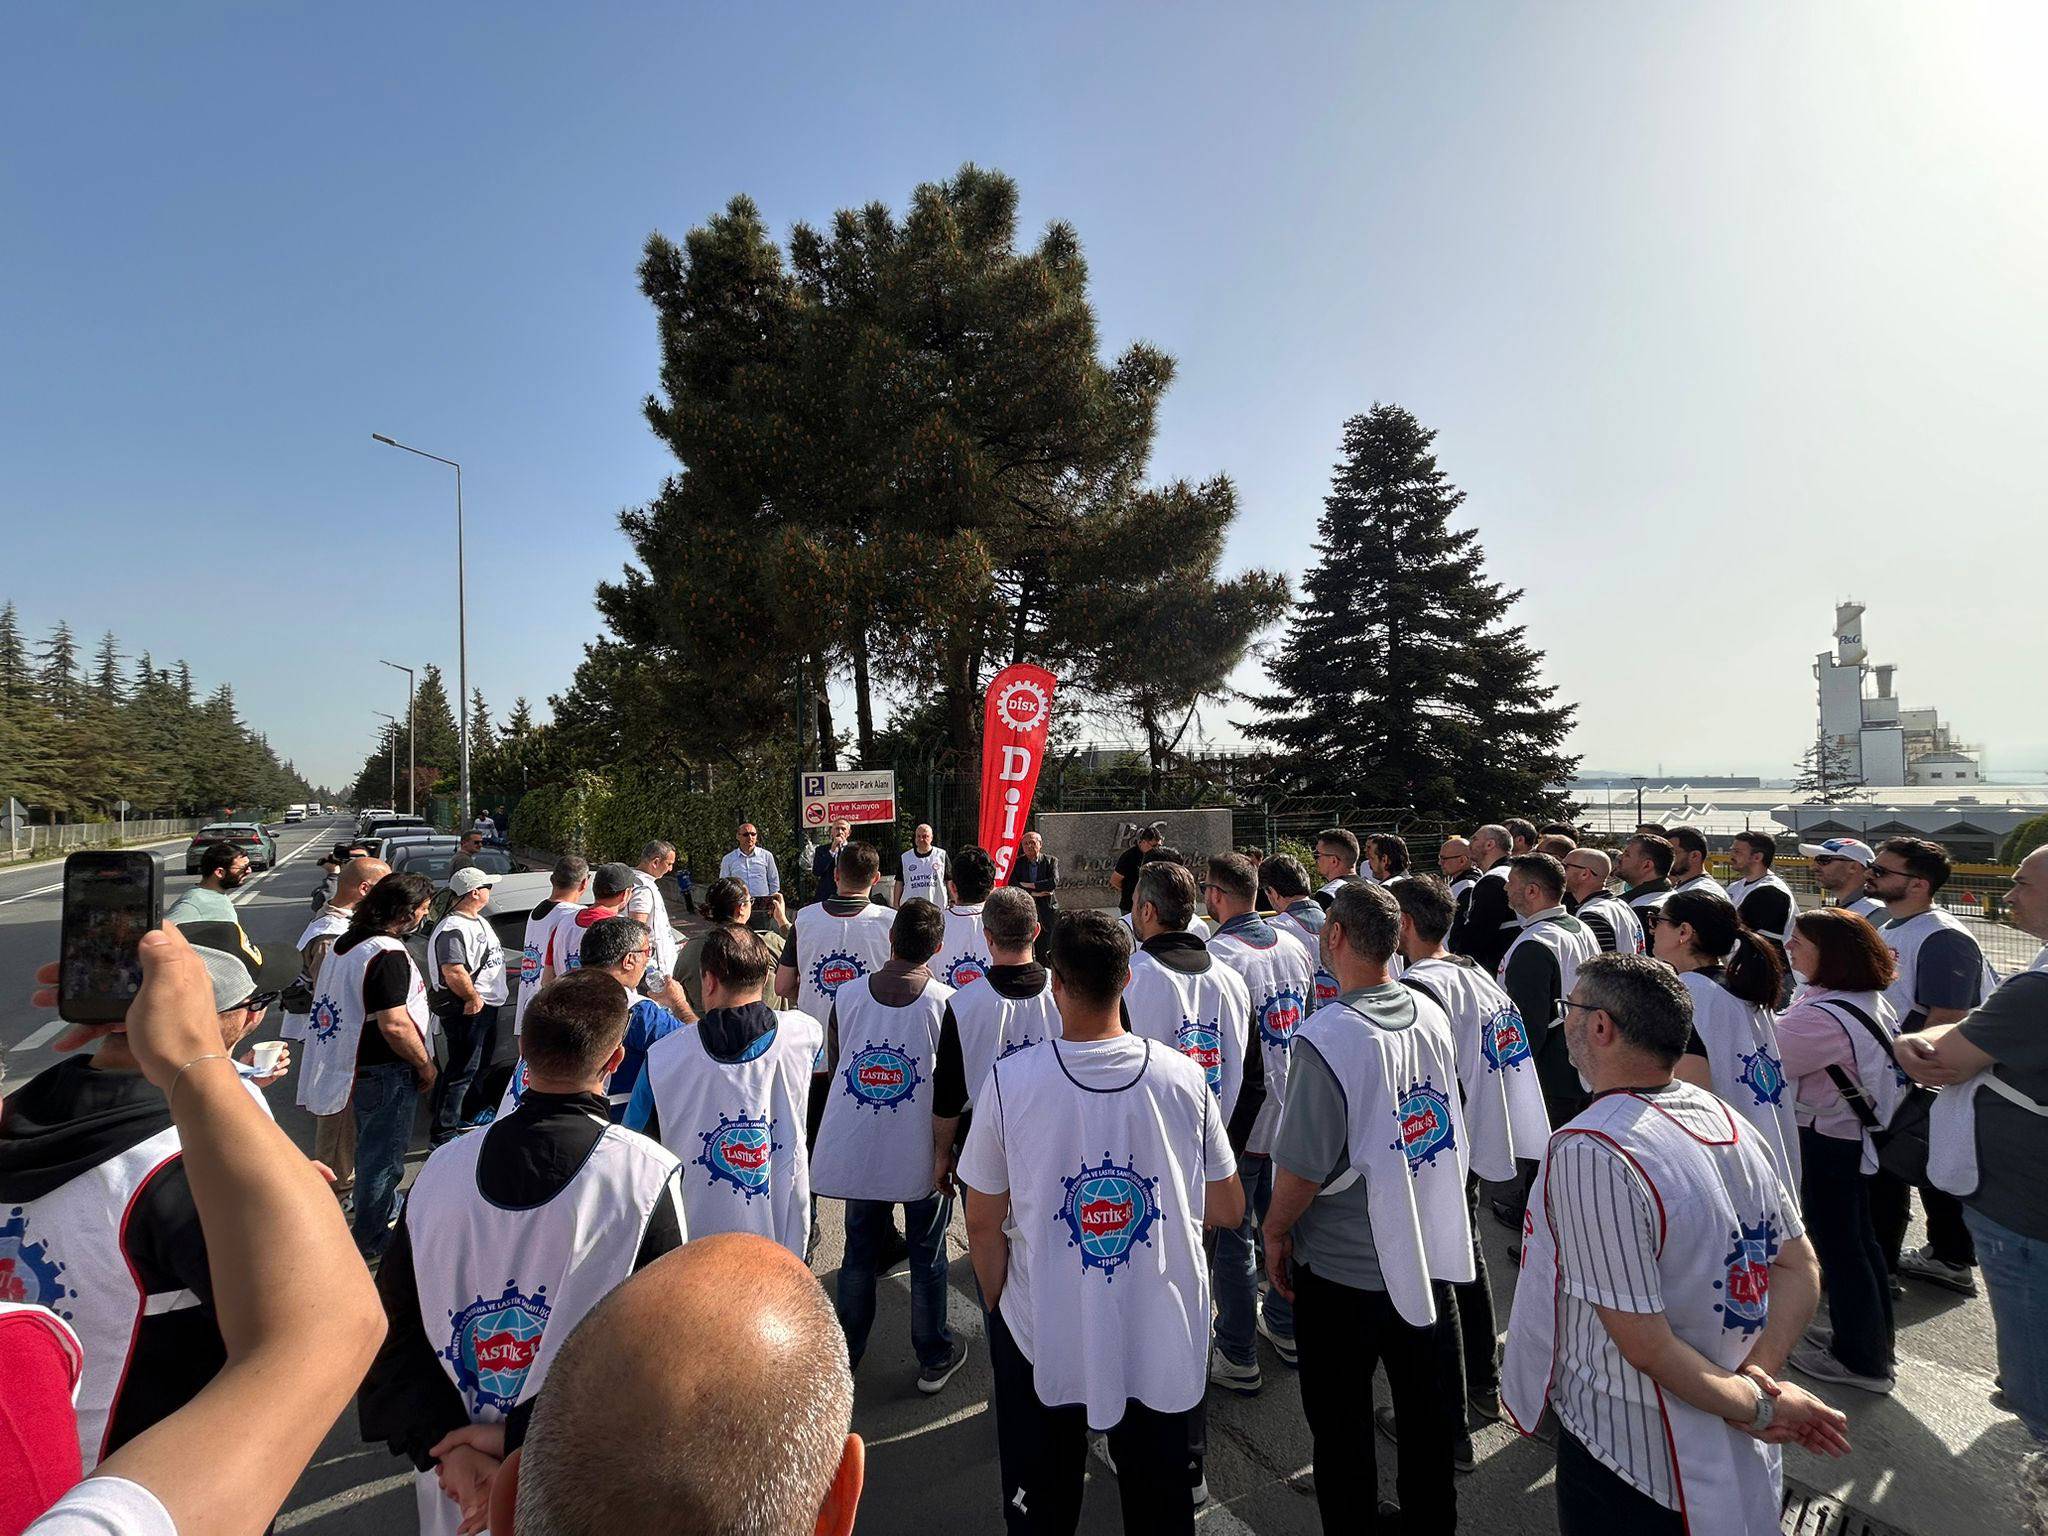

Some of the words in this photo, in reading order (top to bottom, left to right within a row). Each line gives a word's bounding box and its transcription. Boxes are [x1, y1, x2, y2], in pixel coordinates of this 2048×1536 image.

[1839, 634, 1861, 646] P&G
[831, 781, 859, 790] Otomobil
[860, 781, 873, 789] Park
[874, 780, 889, 788] Alanı
[851, 803, 880, 812] Kamyon
[995, 745, 1032, 881] DİS
[861, 1070, 902, 1084] LASTİK-İŞ
[1101, 1257, 1118, 1267] 1949
